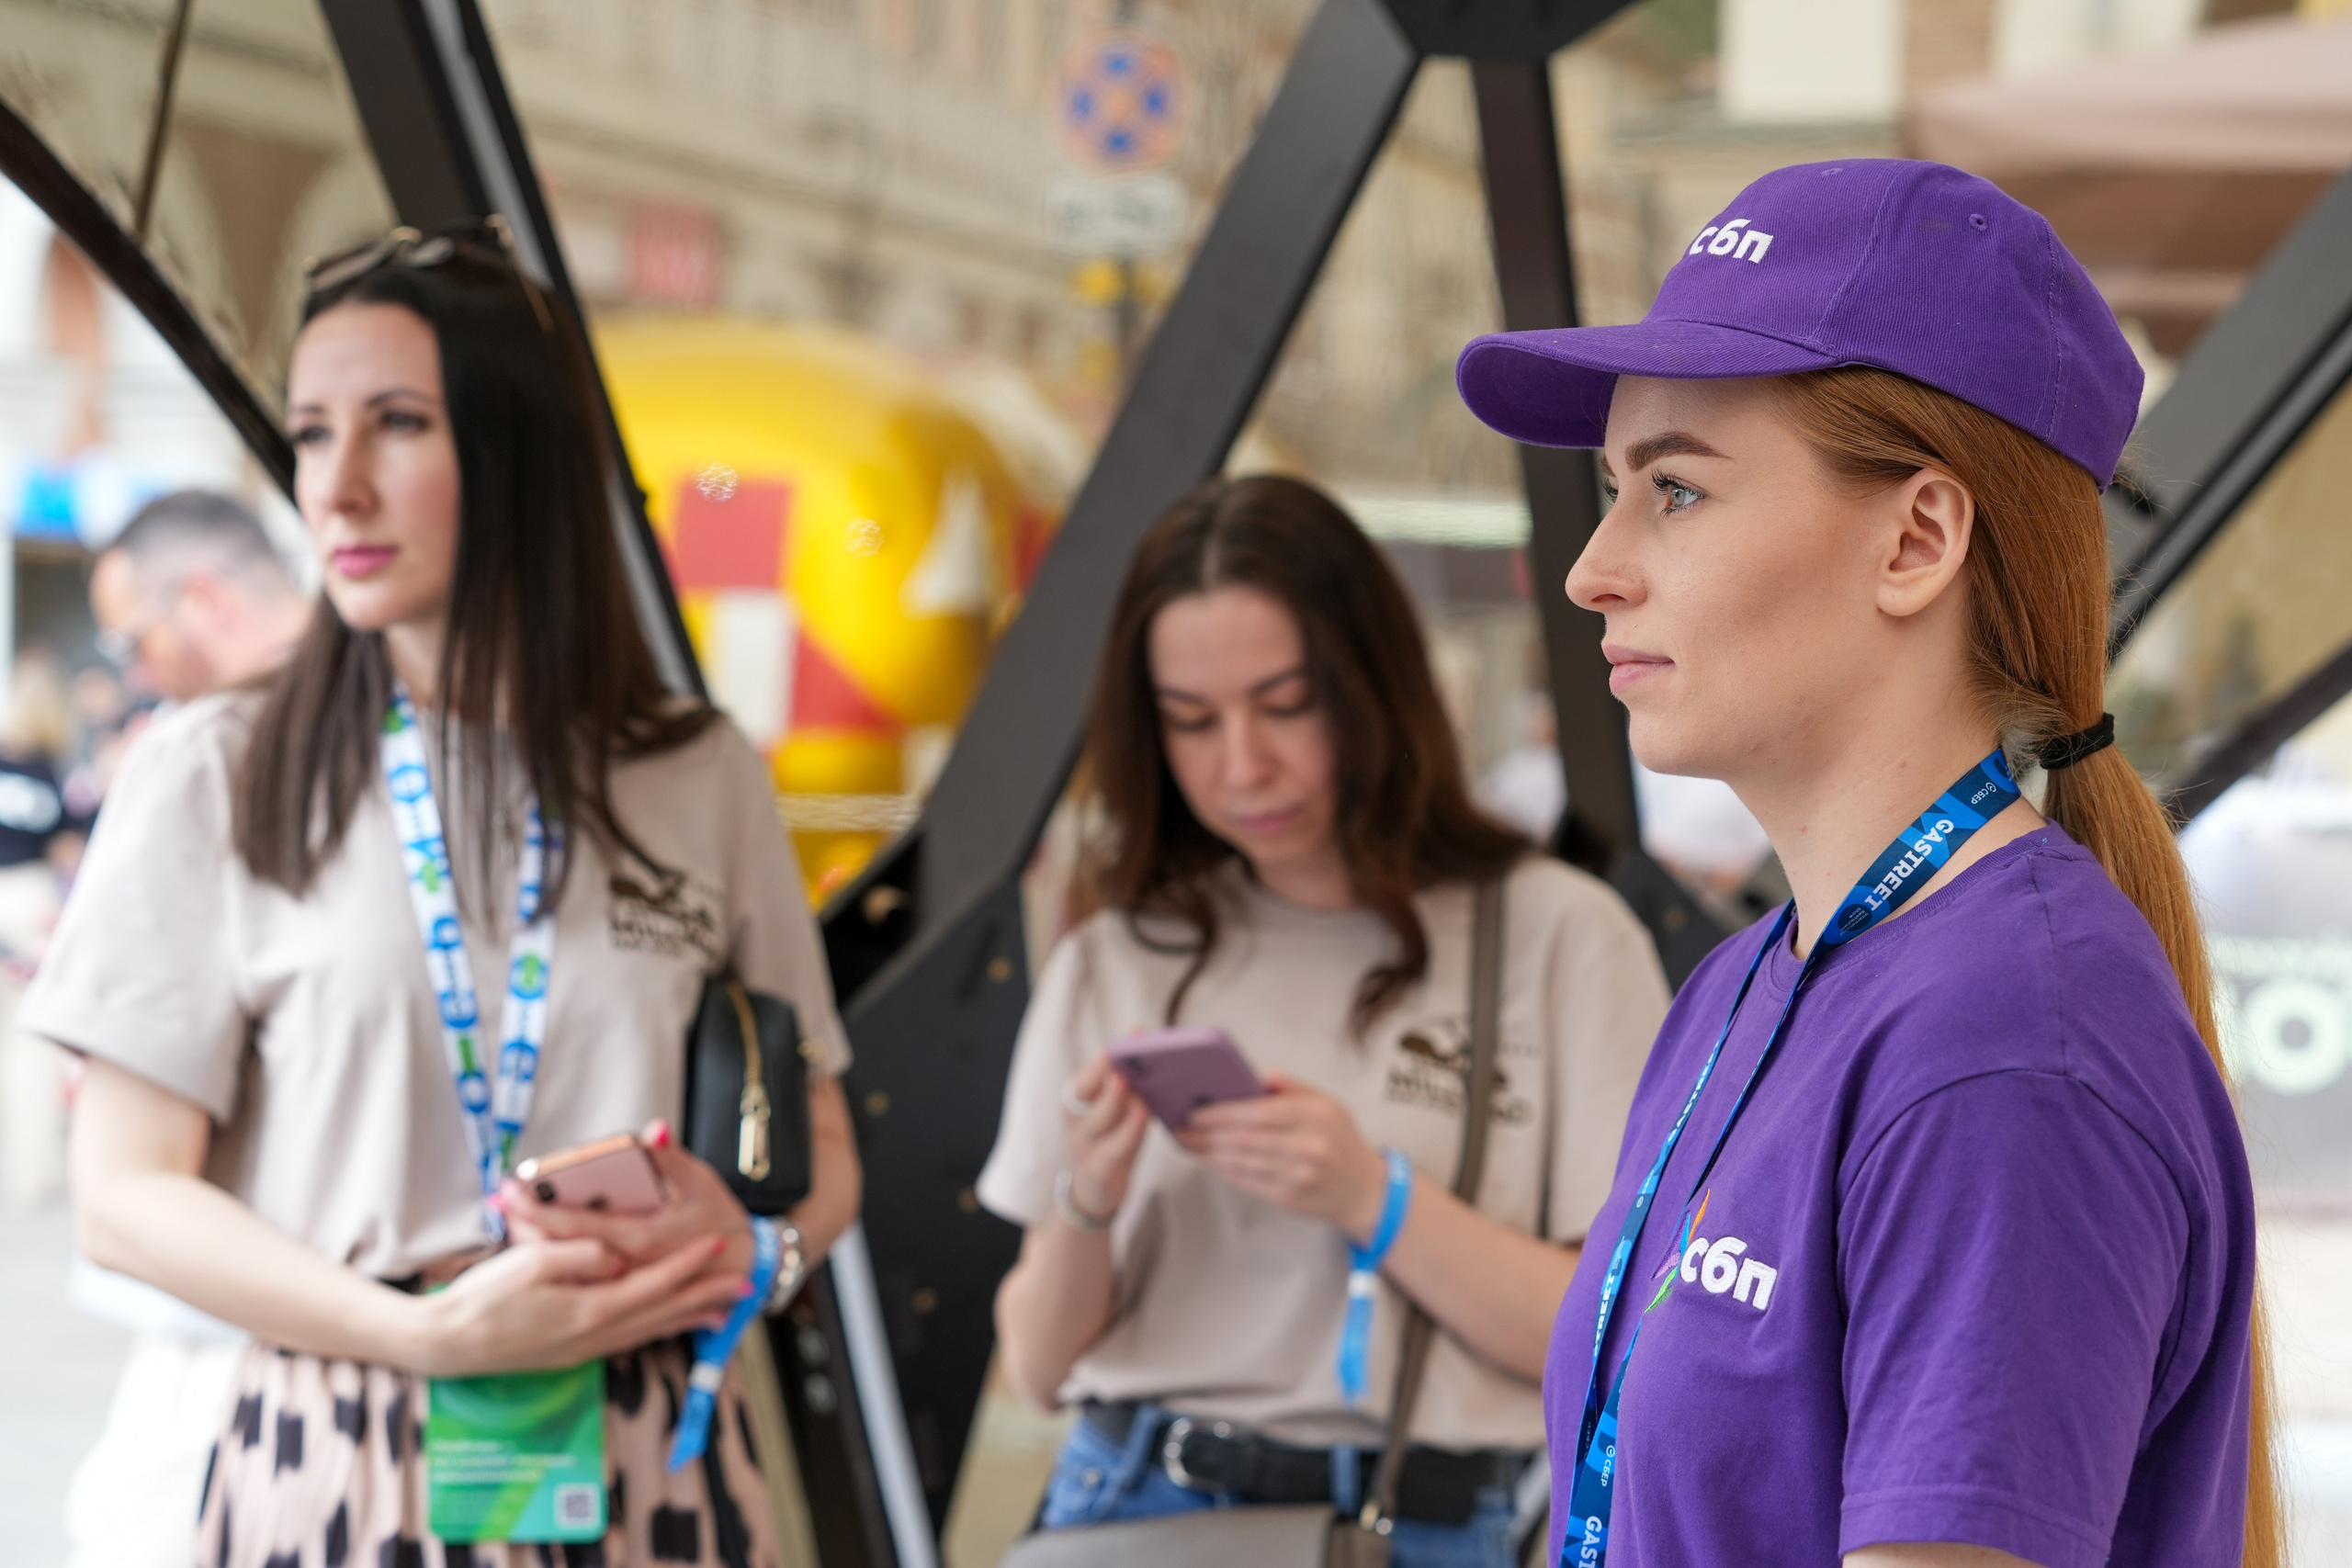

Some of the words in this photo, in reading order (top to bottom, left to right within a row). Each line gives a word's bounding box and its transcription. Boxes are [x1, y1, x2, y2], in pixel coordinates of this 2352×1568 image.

[1689, 219, 1774, 265] сбп
[1971, 788, 1989, 805] СБЕР
[1863, 818, 1954, 911] GASTREET
[1679, 1236, 1778, 1311] сбп
[1600, 1459, 1611, 1487] СБЕР
